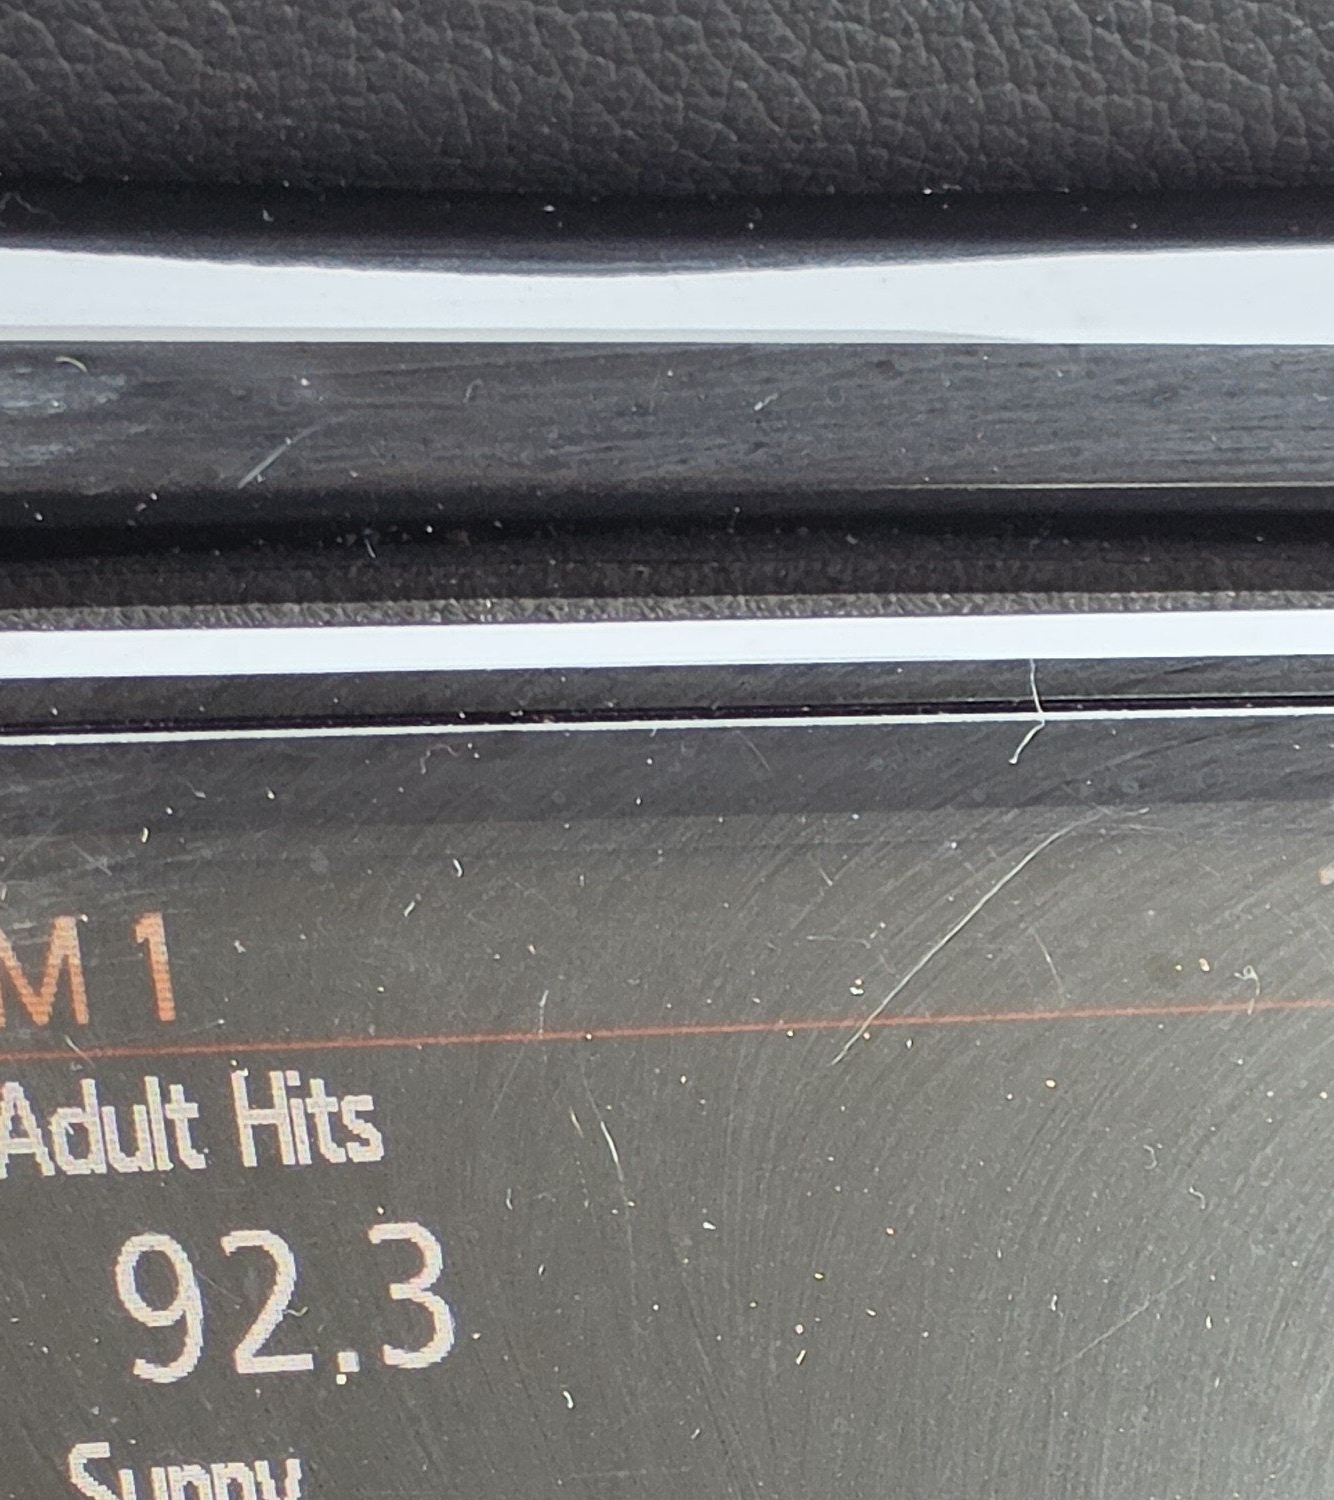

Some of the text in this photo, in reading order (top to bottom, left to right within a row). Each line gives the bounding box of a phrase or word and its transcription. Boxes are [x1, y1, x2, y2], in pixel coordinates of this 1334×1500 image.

[132, 911, 178, 1023] 1
[232, 1069, 385, 1168] Hits
[114, 1221, 457, 1385] 92.3
